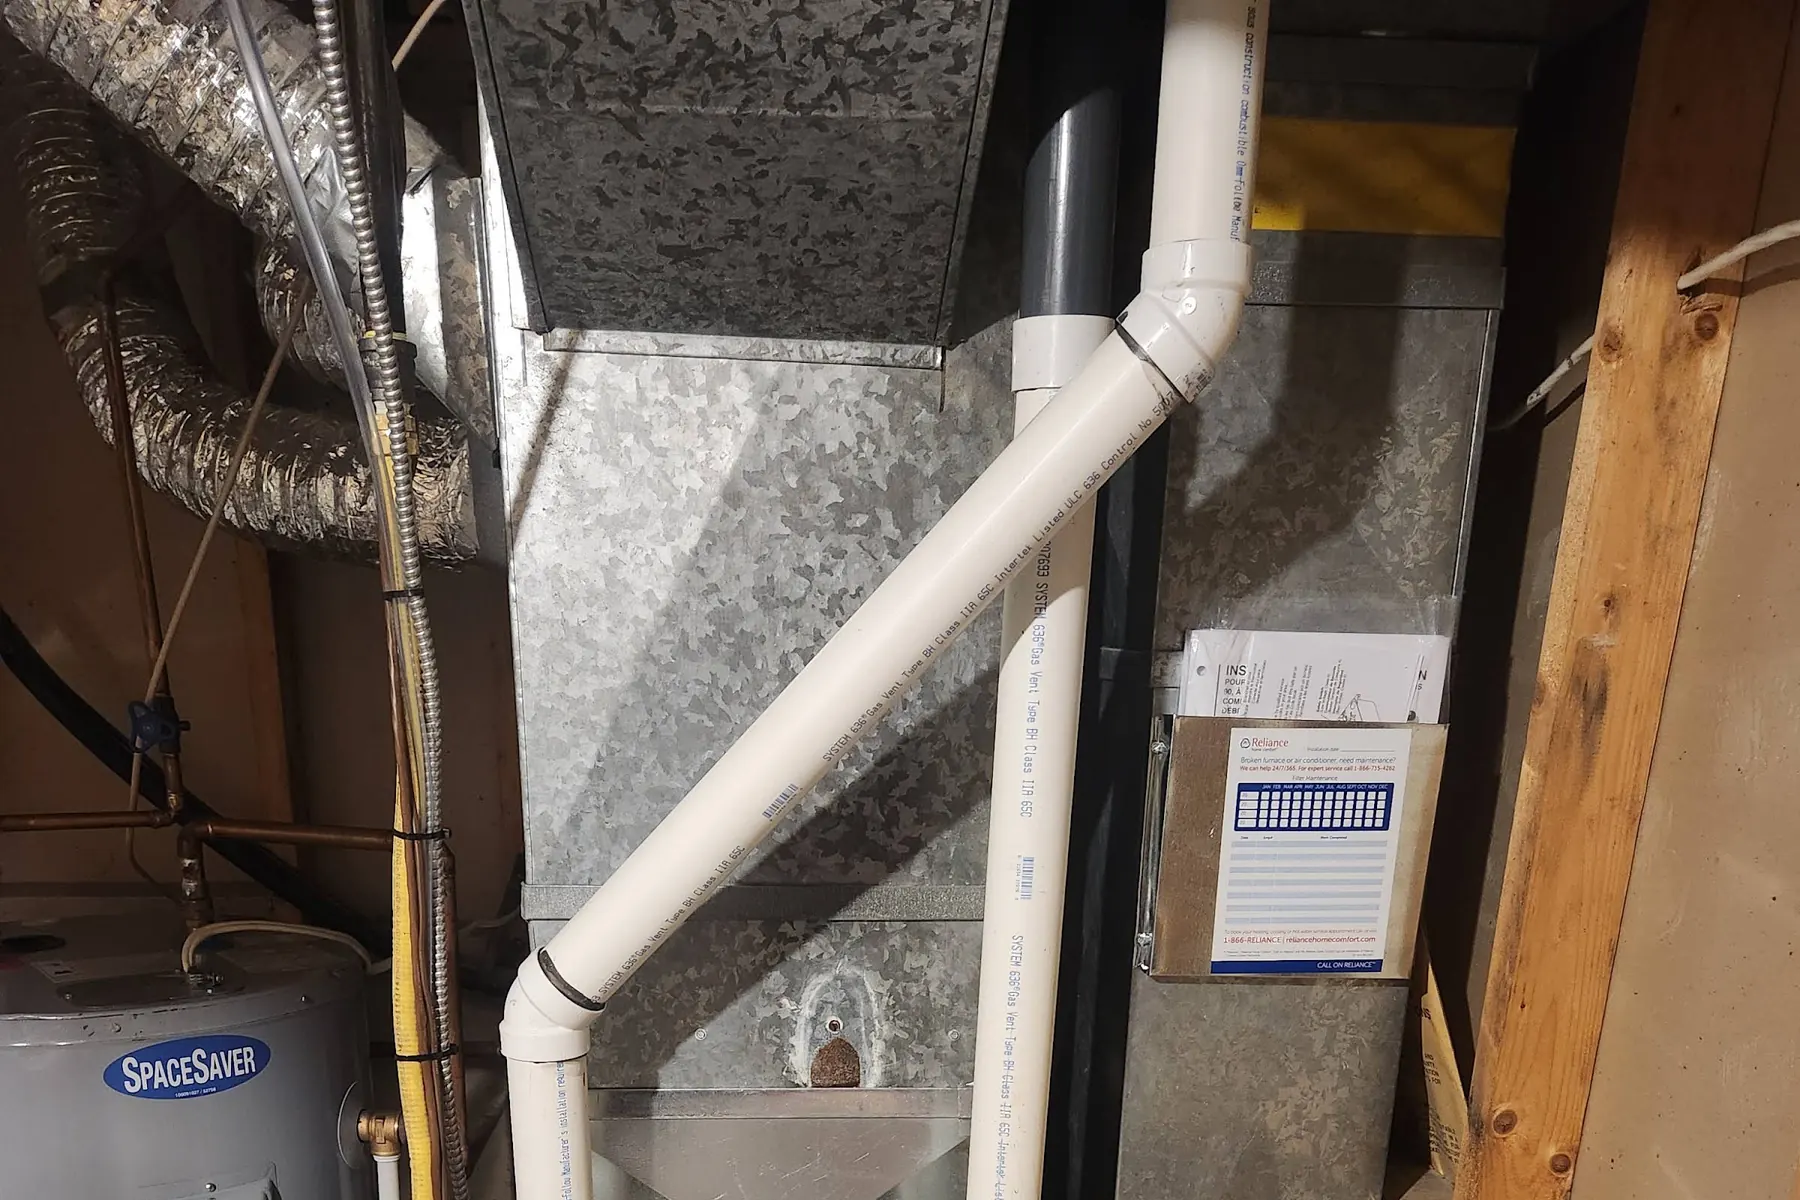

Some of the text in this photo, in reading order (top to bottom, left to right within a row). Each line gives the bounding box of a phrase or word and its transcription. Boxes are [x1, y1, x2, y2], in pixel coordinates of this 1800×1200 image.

[1242, 33, 1254, 95] construction
[1237, 100, 1250, 156] combustible
[823, 734, 852, 761] SYSTEM
[881, 682, 903, 699] Vent
[901, 660, 923, 678] Type
[922, 645, 936, 658] BH
[935, 621, 960, 644] Class
[960, 602, 978, 618] IIA
[977, 584, 994, 600] 65C
[994, 545, 1032, 584] Intertek
[1032, 509, 1064, 542] Listed
[1064, 490, 1082, 508] ULC
[1083, 471, 1103, 489] 636
[1101, 433, 1138, 472] Control
[1138, 419, 1152, 431] No
[1034, 583, 1048, 619] SYSTEM
[1226, 665, 1247, 676] INS
[1029, 671, 1042, 693] Vent
[1027, 700, 1040, 723] Type
[1026, 728, 1038, 740] BH
[1252, 738, 1289, 748] Reliance
[1023, 745, 1037, 773] Class
[1302, 757, 1338, 765] conditioner,
[1355, 756, 1397, 764] maintenance?
[1022, 780, 1034, 796] IIA
[1020, 801, 1032, 817] 65C
[598, 971, 624, 994] SYSTEM
[648, 928, 668, 941] Vent
[665, 909, 685, 923] Type
[682, 897, 696, 907] BH
[693, 876, 718, 896] Class
[715, 860, 731, 877] IIA
[729, 846, 747, 859] 65C
[1010, 935, 1023, 966] SYSTEM
[1223, 936, 1281, 944] 1-866-RELIANCE
[1006, 1012, 1018, 1032] Vent
[1004, 1036, 1016, 1056] Type
[1003, 1059, 1014, 1072] BH
[1001, 1074, 1013, 1099] Class
[557, 1090, 568, 1128] installation
[1000, 1102, 1011, 1119] IIA
[998, 1122, 1010, 1137] 65C
[996, 1141, 1009, 1179] Intertek
